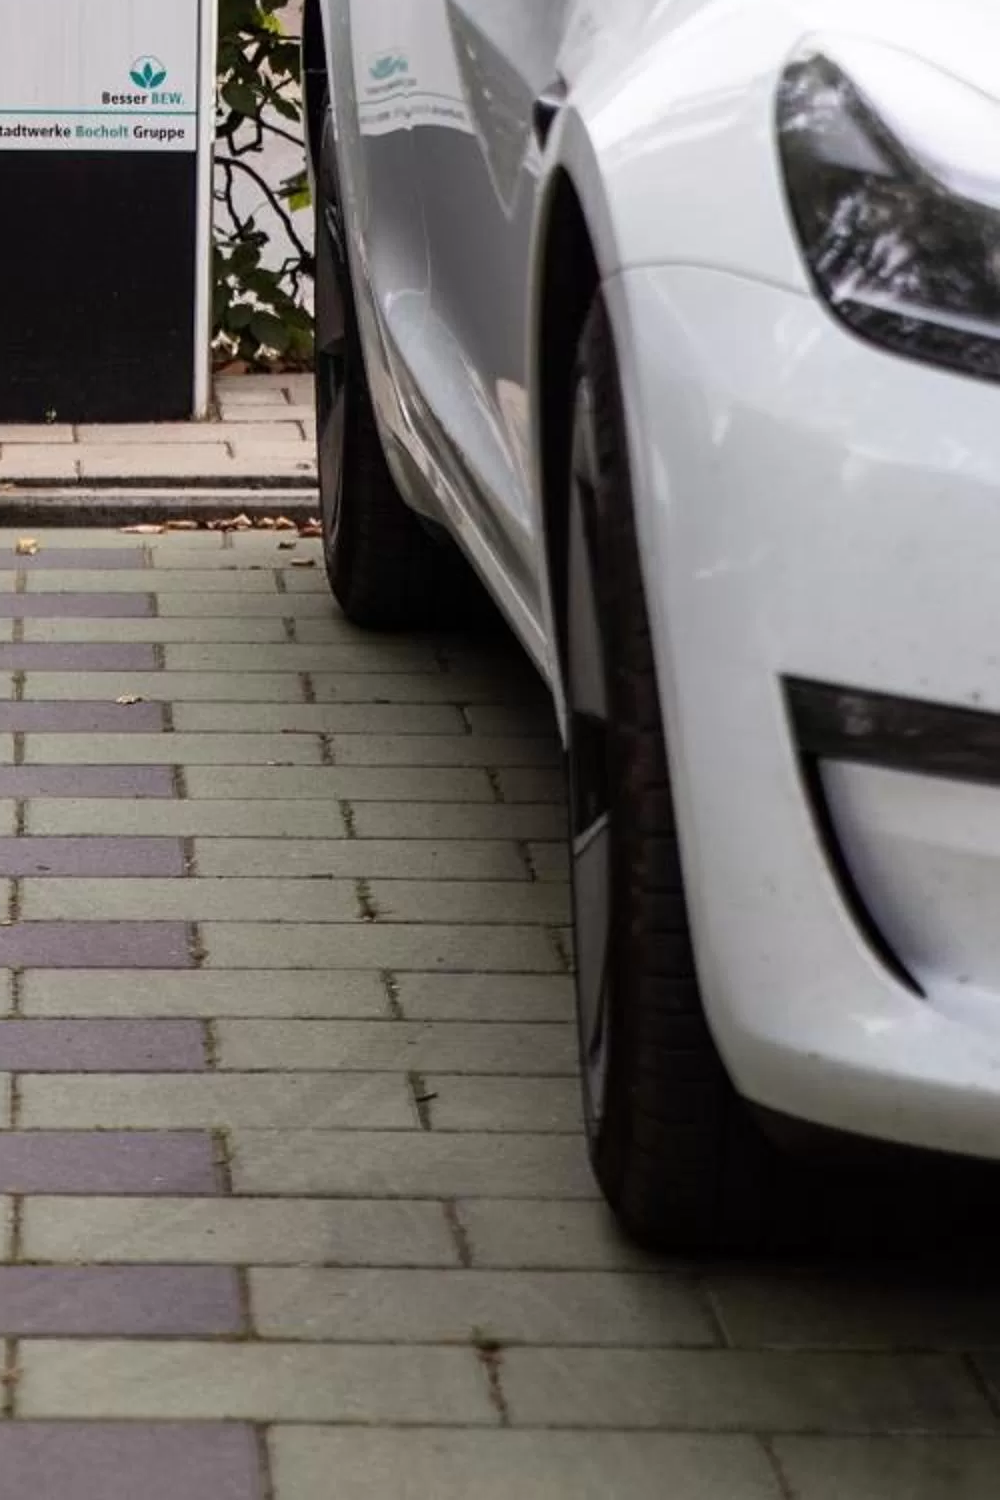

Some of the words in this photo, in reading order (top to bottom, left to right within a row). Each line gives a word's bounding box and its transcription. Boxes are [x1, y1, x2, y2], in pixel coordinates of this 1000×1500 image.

[101, 91, 148, 105] Besser
[75, 125, 129, 139] Bocholt
[133, 125, 185, 142] Gruppe
